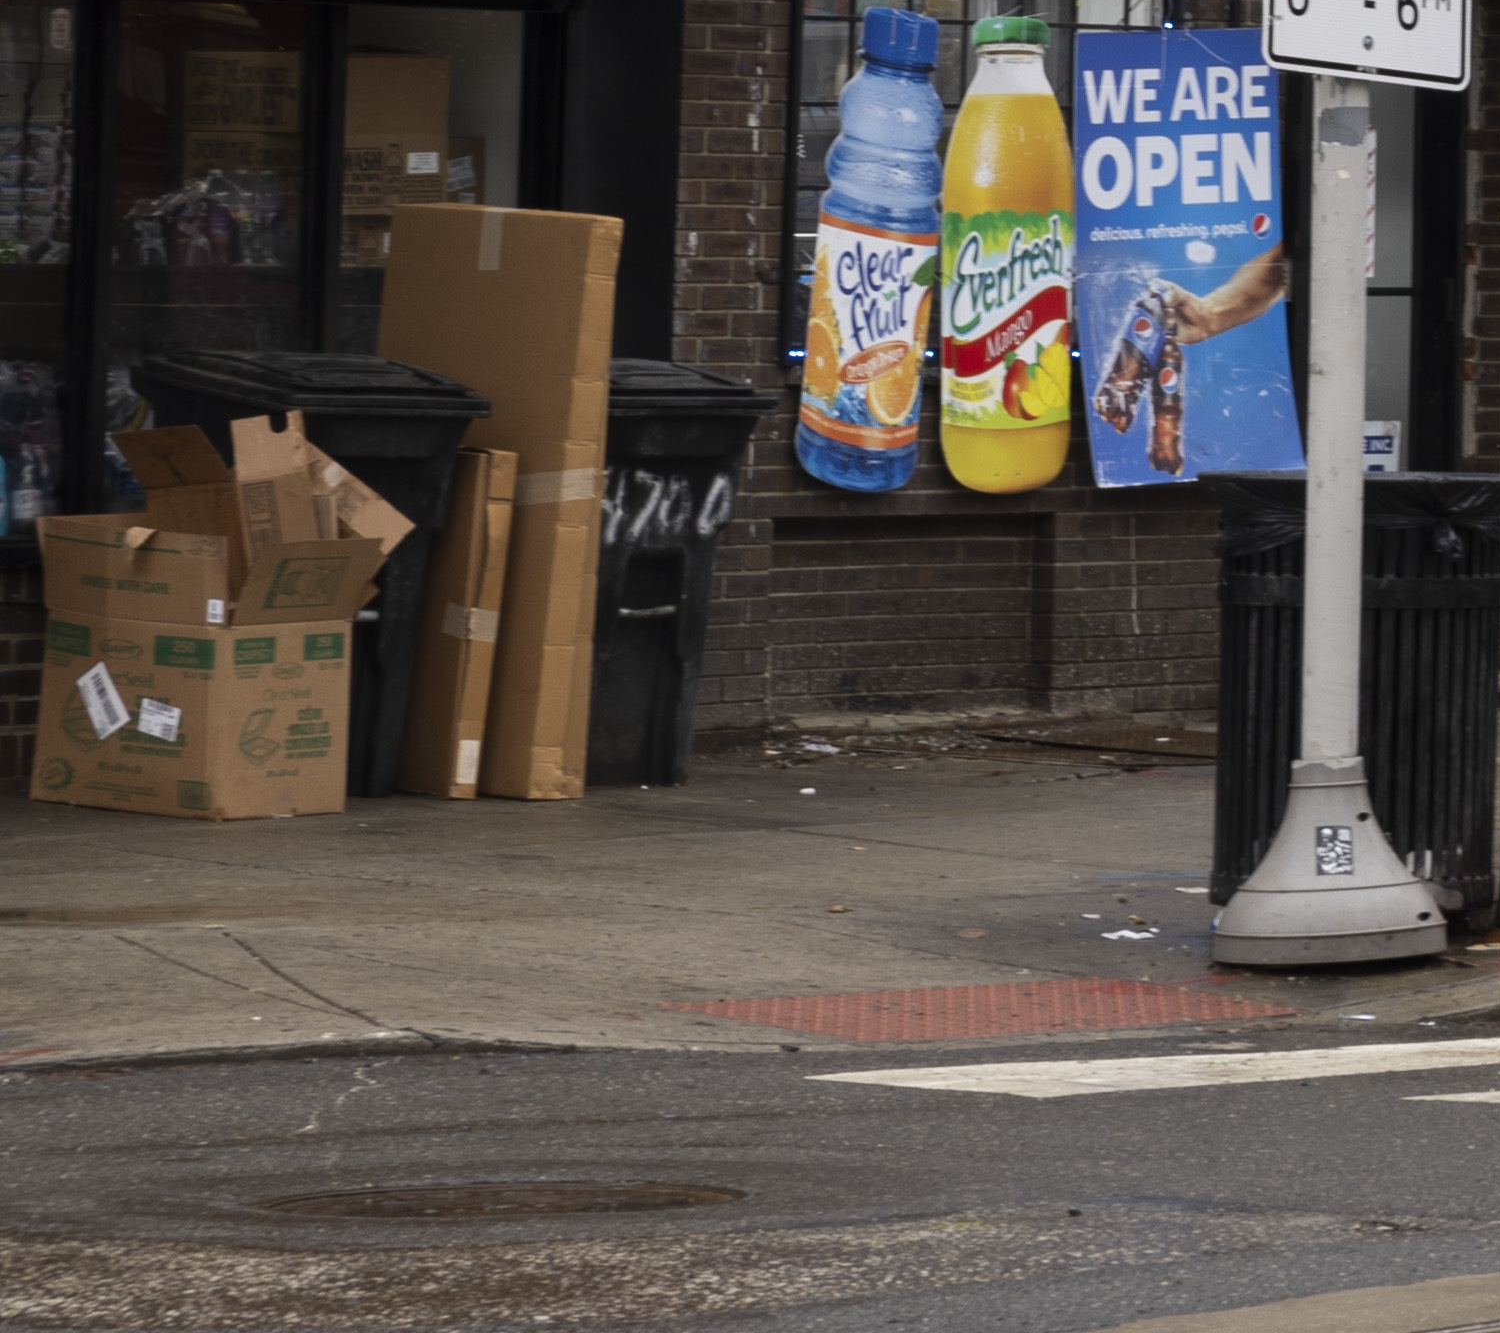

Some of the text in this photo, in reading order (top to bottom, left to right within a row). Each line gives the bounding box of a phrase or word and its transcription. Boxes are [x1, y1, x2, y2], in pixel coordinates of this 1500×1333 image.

[1082, 64, 1271, 125] WE ARE
[1081, 131, 1273, 211] OPEN
[836, 240, 914, 298] clear
[950, 215, 1064, 334] Everfresh
[849, 275, 913, 352] fruit
[984, 310, 1034, 363] Mango
